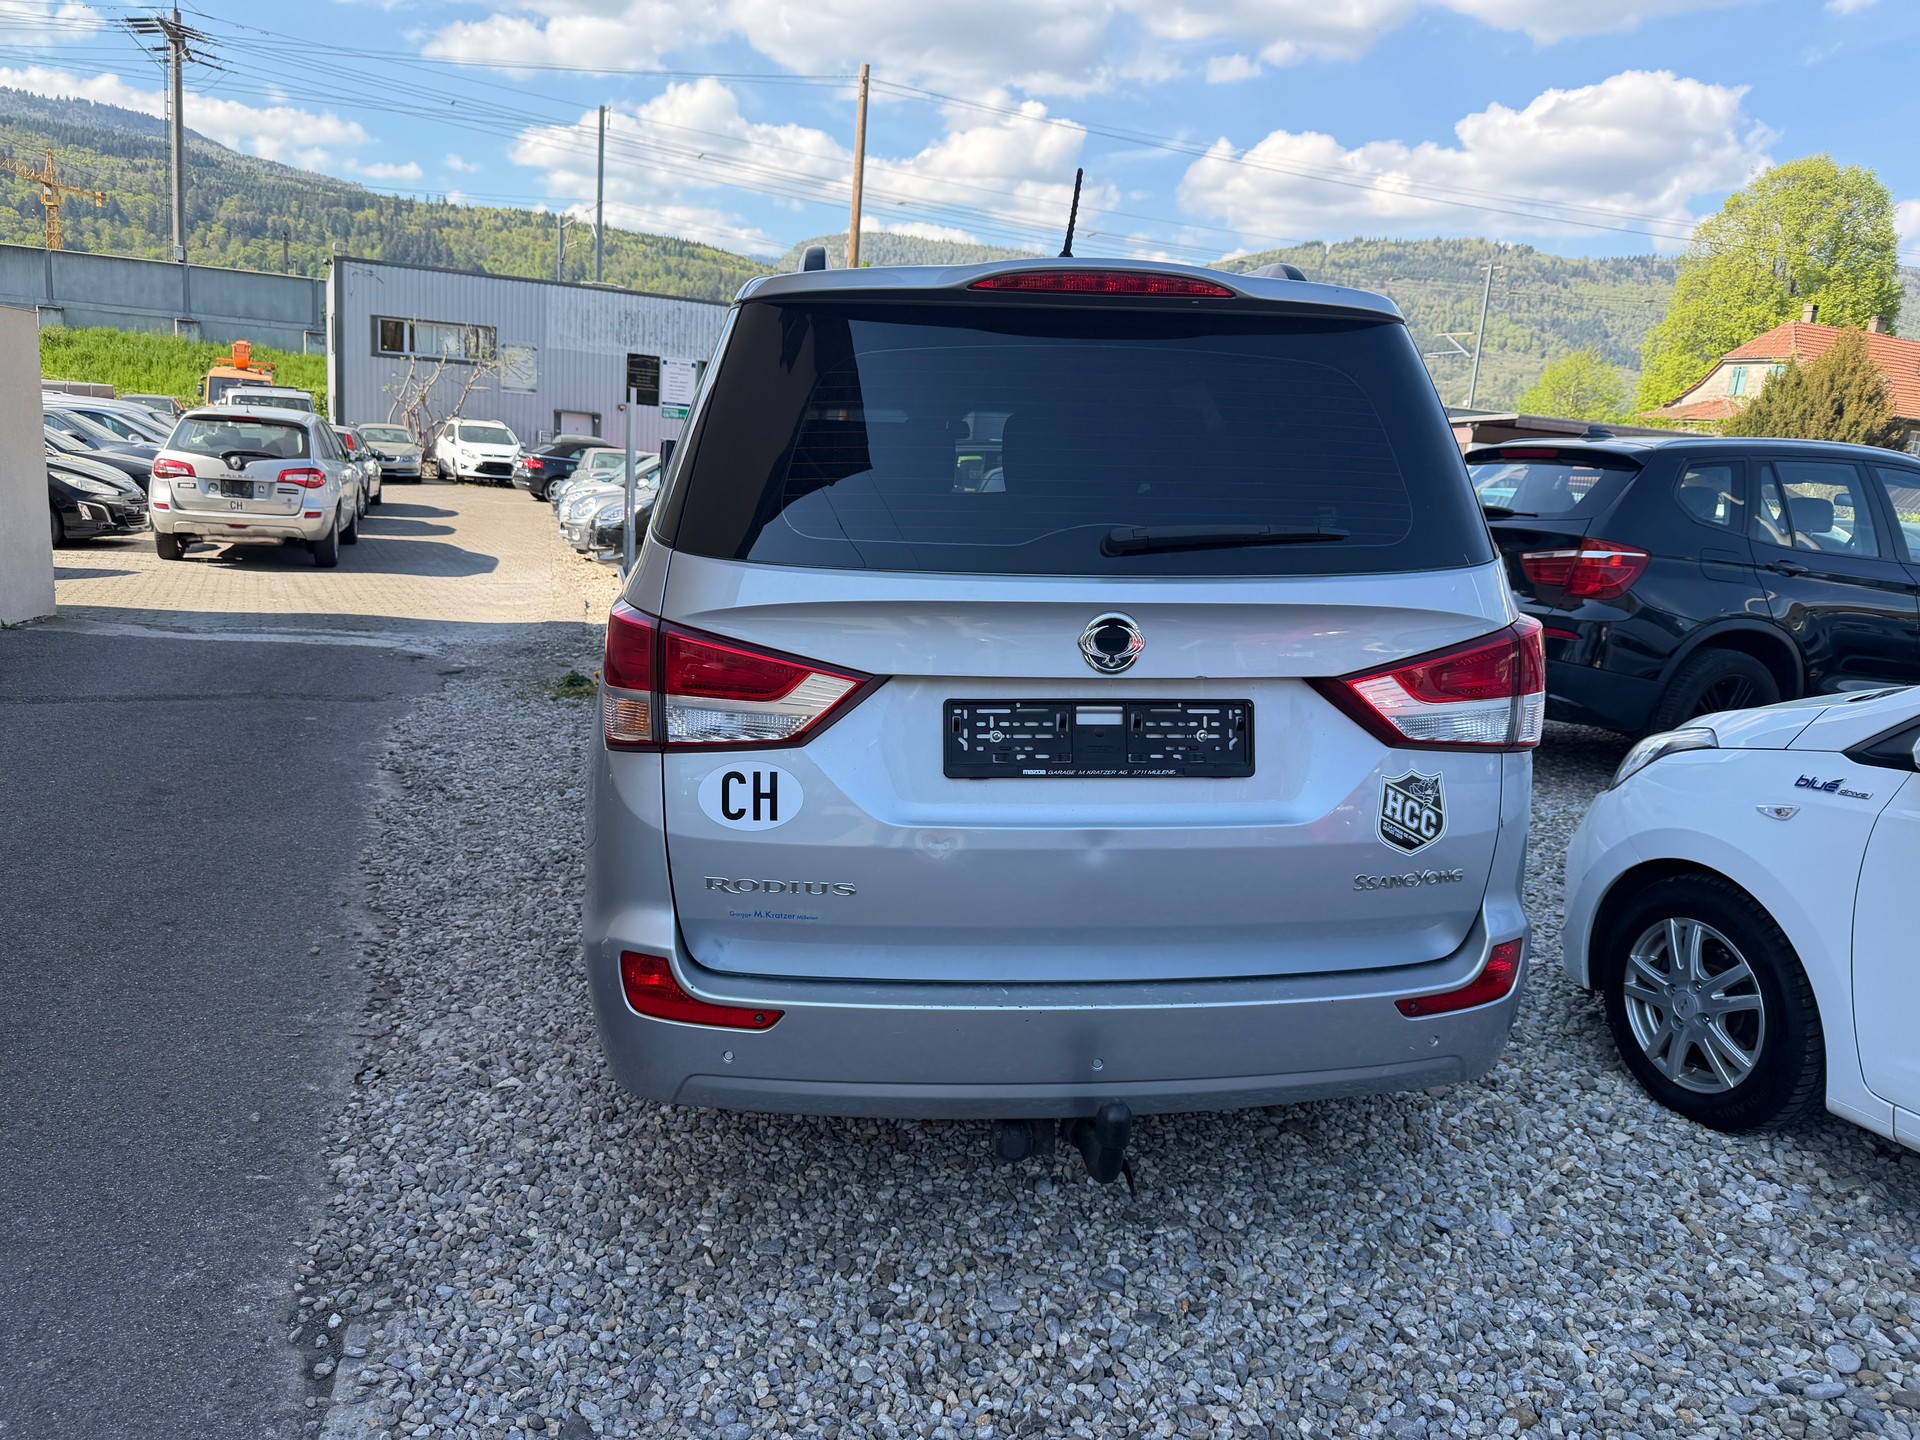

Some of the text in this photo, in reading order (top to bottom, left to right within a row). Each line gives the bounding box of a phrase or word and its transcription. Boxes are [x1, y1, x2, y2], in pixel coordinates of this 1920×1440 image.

[229, 501, 243, 511] CH
[721, 771, 778, 821] CH
[1794, 774, 1869, 798] blue drive
[1384, 786, 1437, 838] HCC
[704, 875, 857, 897] RODIUS
[729, 910, 752, 919] Garage
